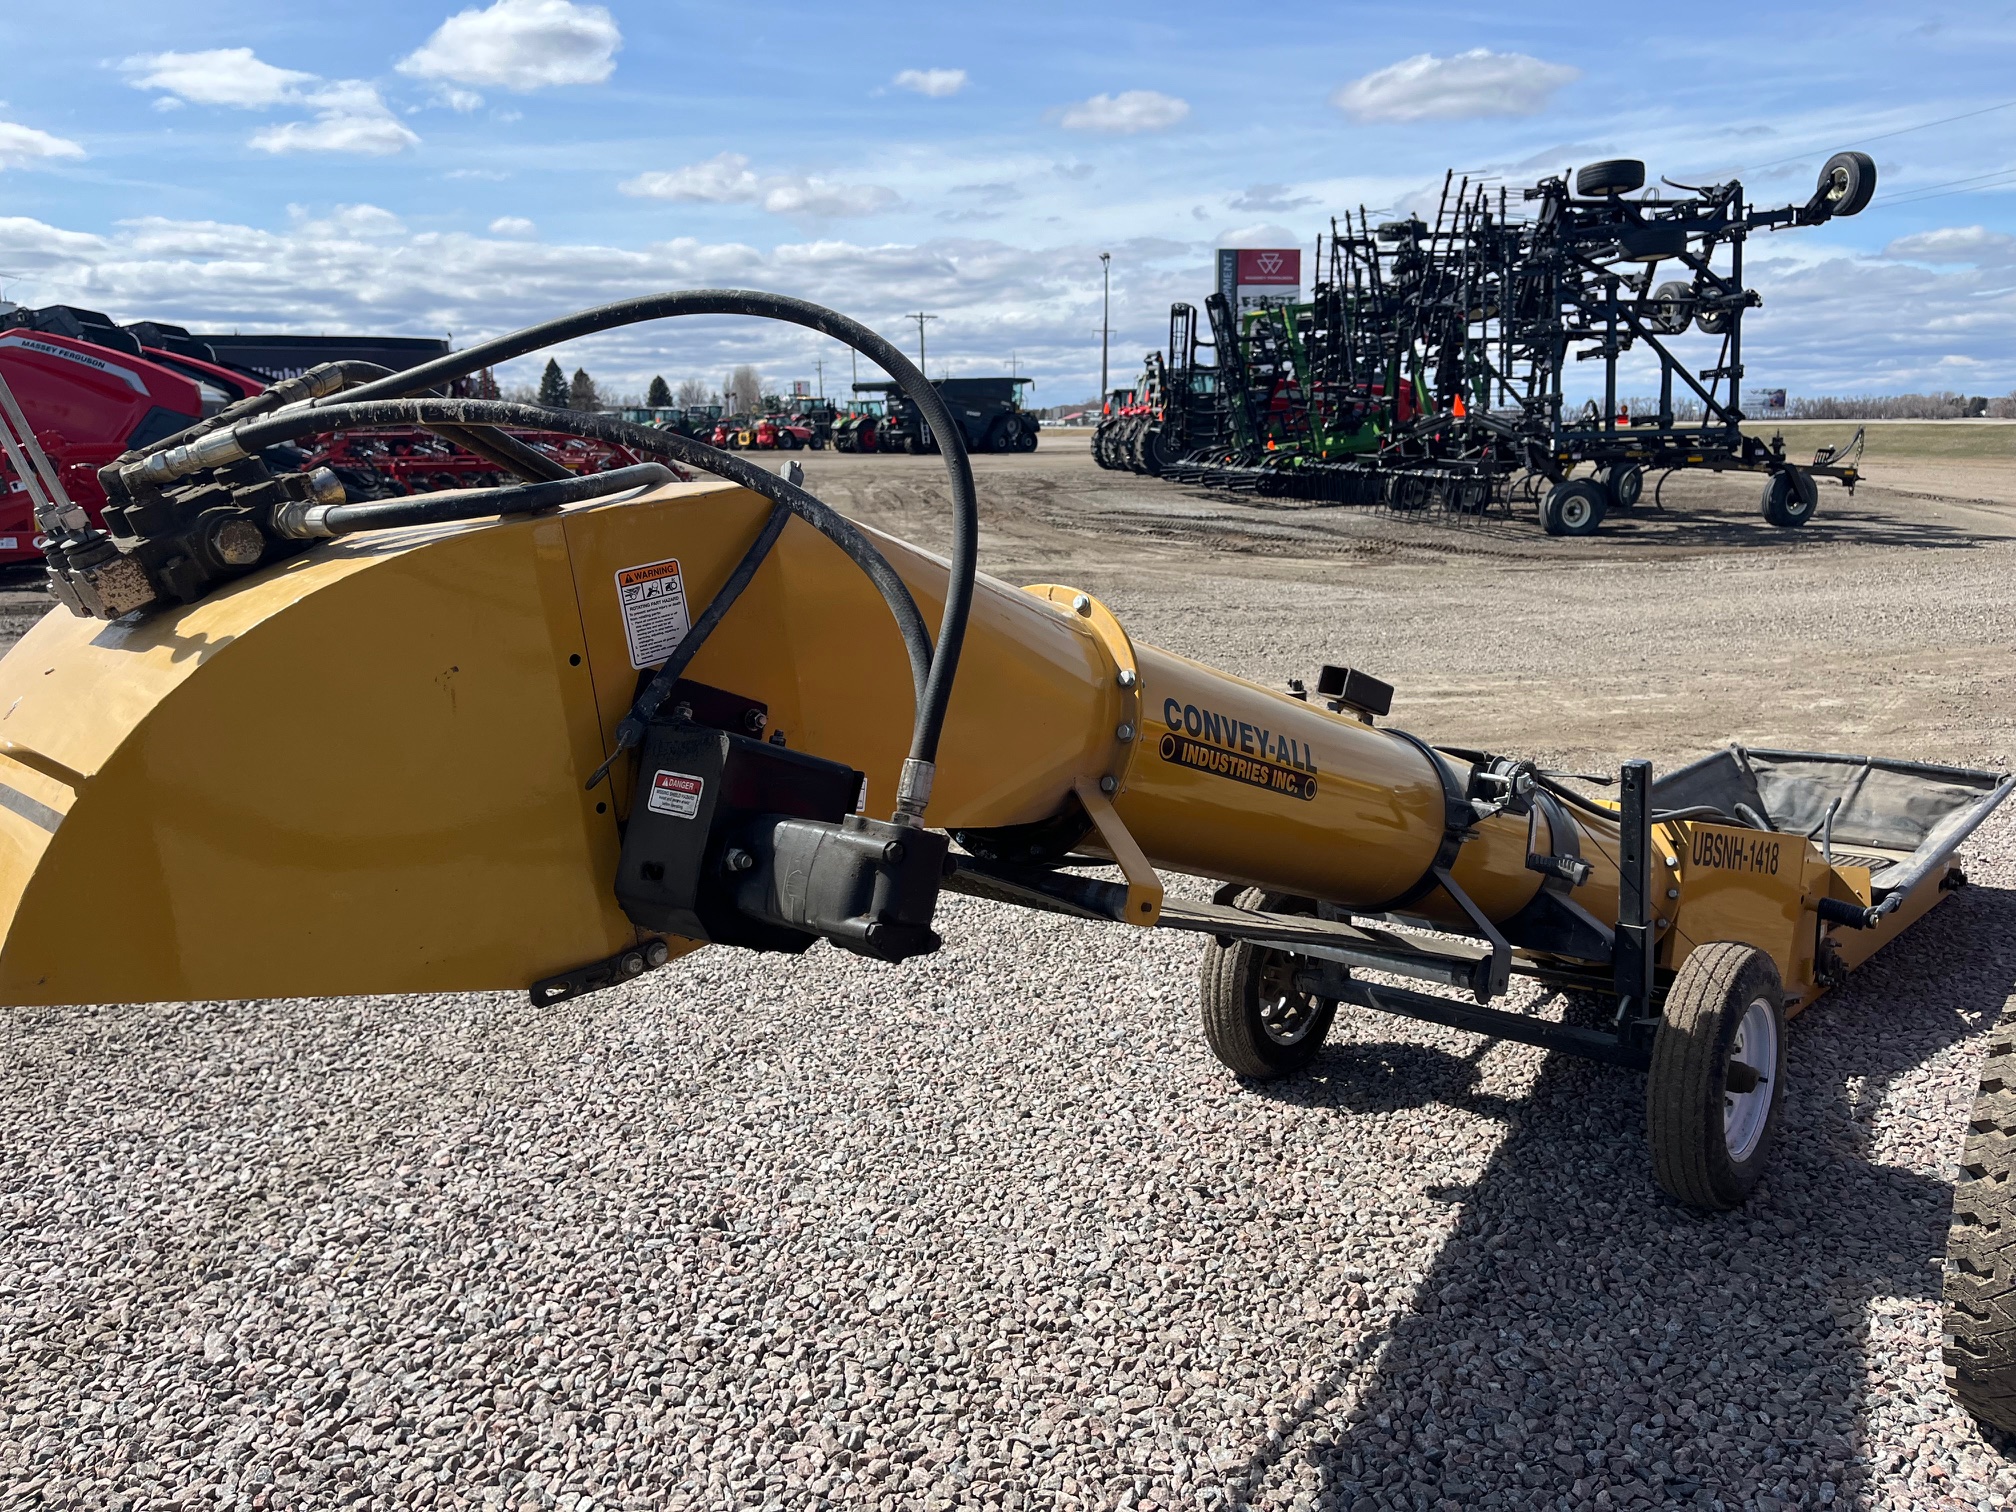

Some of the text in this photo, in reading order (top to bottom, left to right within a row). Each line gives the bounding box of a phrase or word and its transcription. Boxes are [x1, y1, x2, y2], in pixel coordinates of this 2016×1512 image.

[22, 340, 106, 368] MASSEY FERGUSON
[634, 565, 674, 580] WARNING
[1164, 698, 1318, 774] CONVEY-ALL
[669, 779, 694, 790] DANGER
[1182, 742, 1298, 794] INDUSTRIES INC.
[1693, 831, 1779, 875] UBSNH-1418
